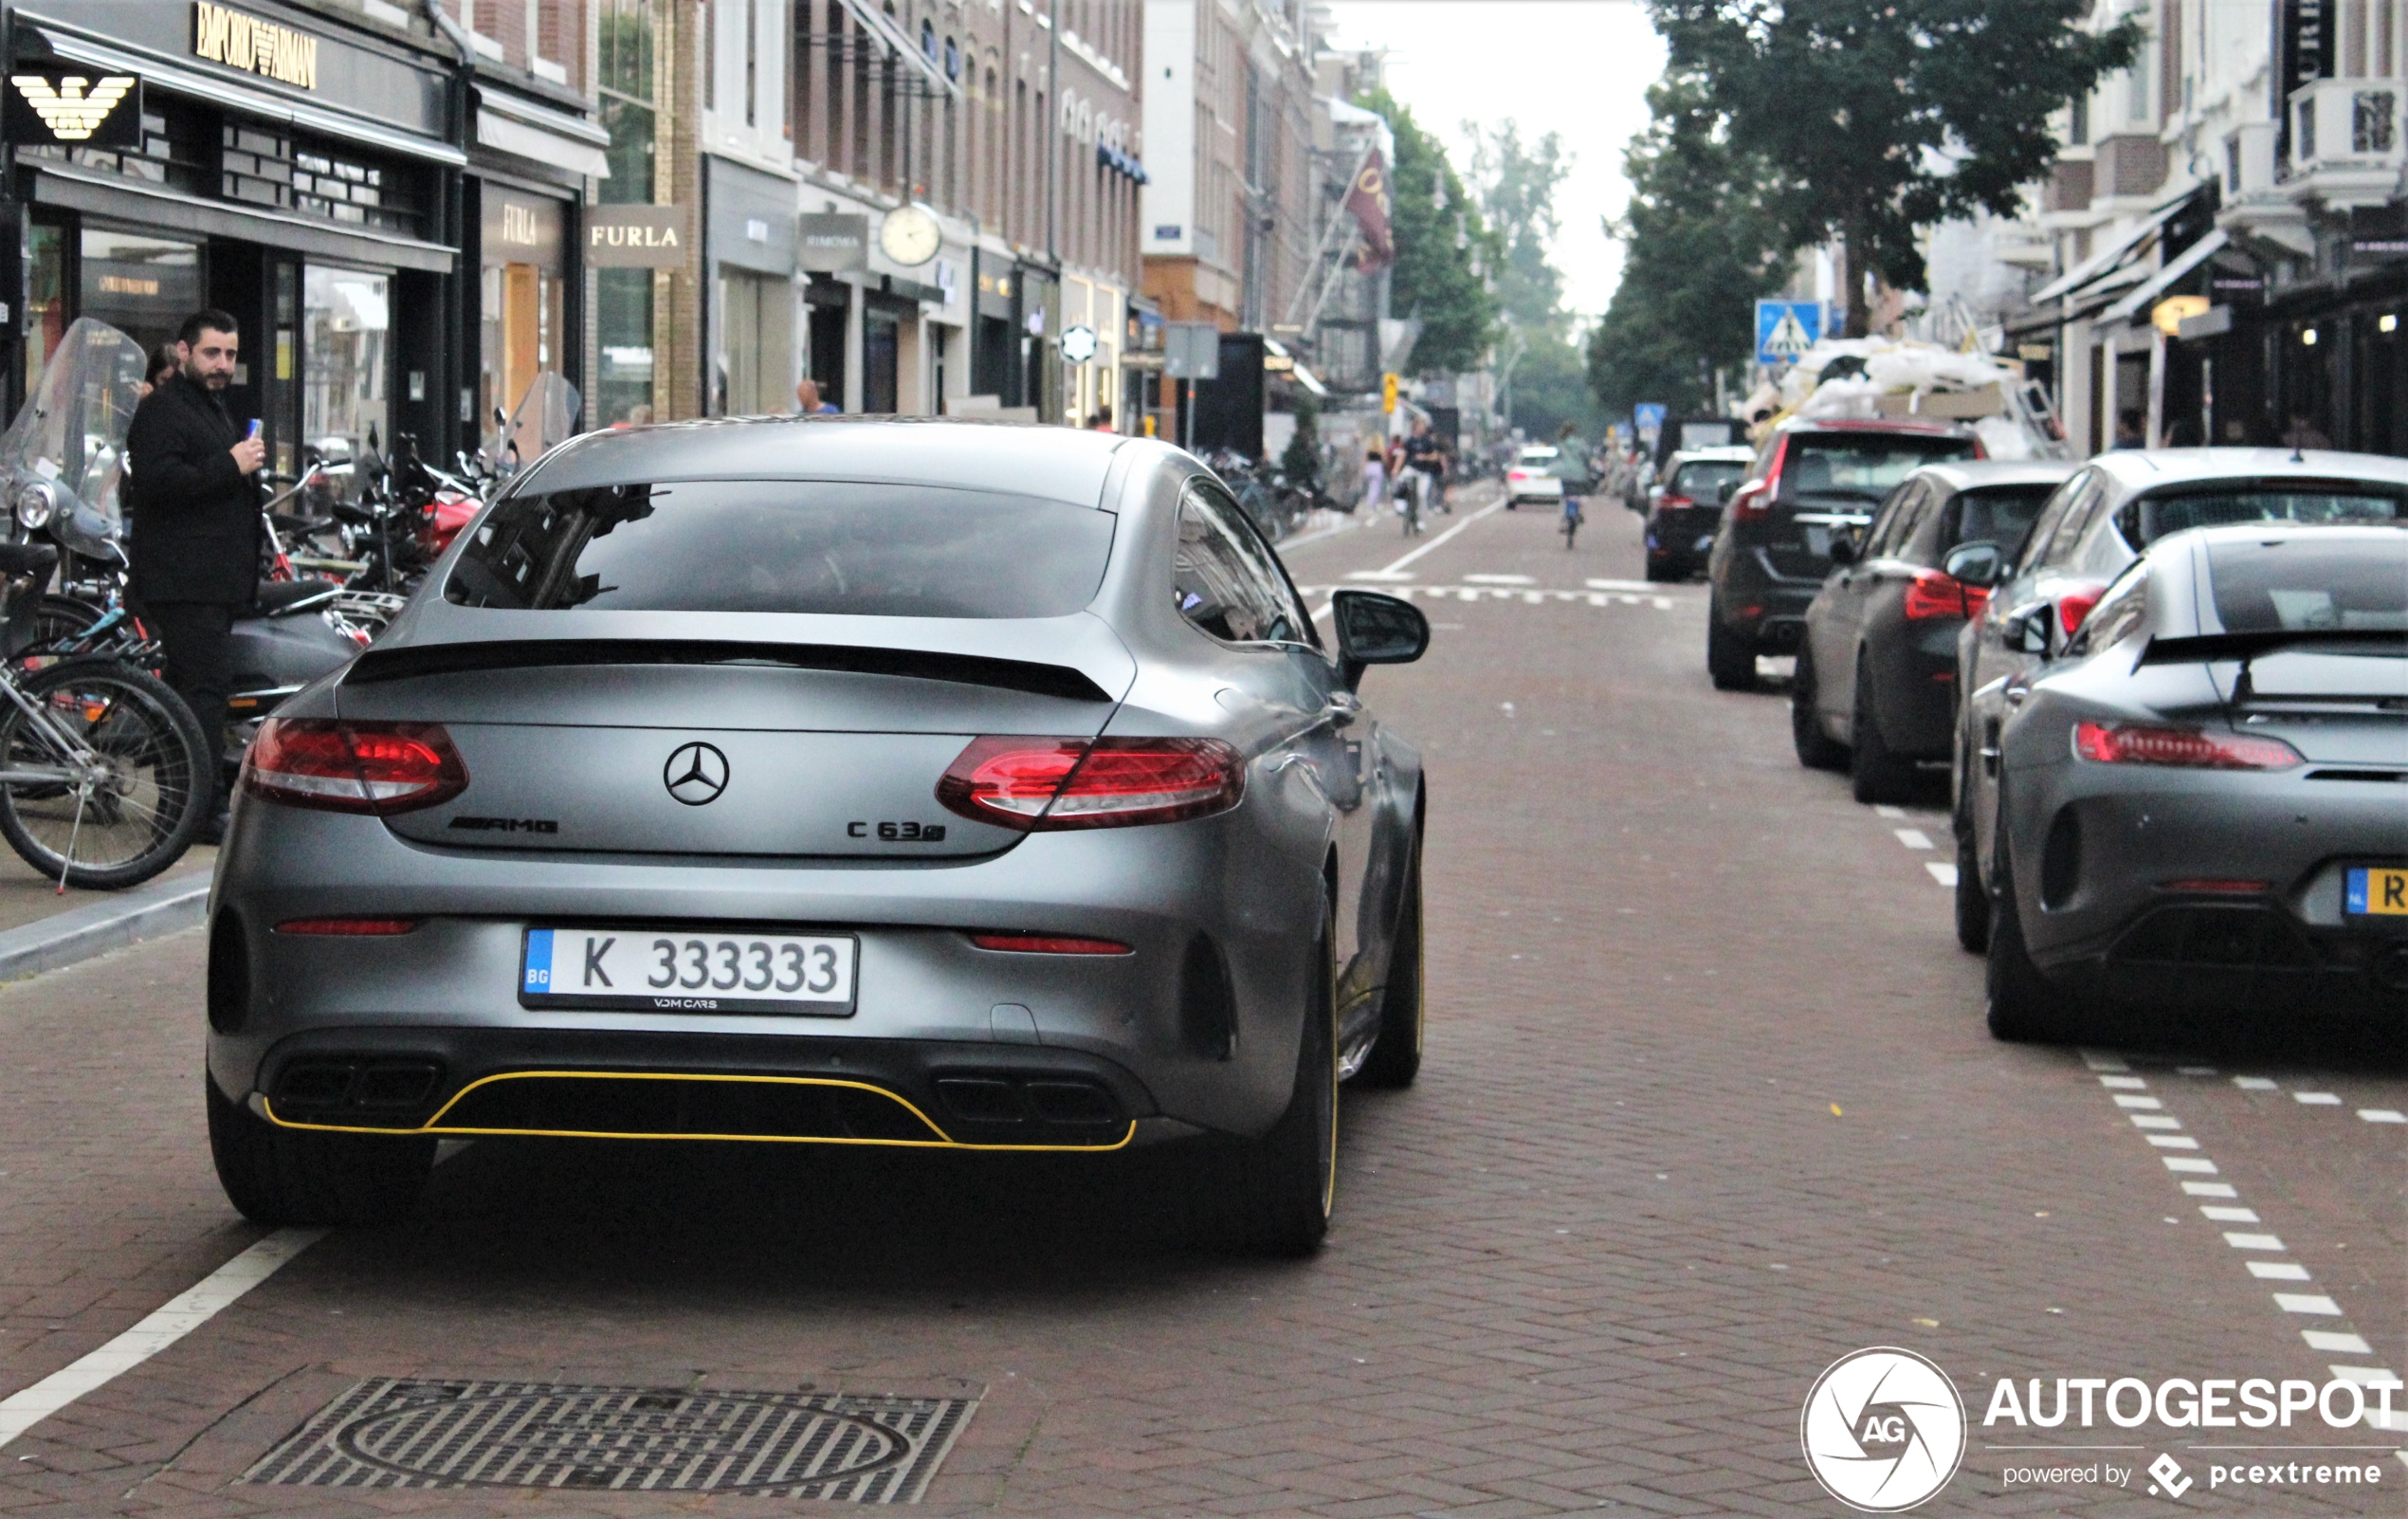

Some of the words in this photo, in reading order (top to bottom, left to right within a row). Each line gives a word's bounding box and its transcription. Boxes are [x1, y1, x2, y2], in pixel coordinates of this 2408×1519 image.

[196, 1, 256, 71] EMPORIO
[270, 25, 317, 89] ARMANI
[503, 204, 537, 246] FURLA
[592, 226, 679, 247] FURLA
[480, 817, 558, 833] AMG
[848, 821, 867, 838] C
[583, 937, 617, 987] K
[648, 939, 837, 994] 333333
[527, 968, 549, 984] BG
[654, 998, 682, 1008] VDM
[684, 999, 718, 1009] CARS
